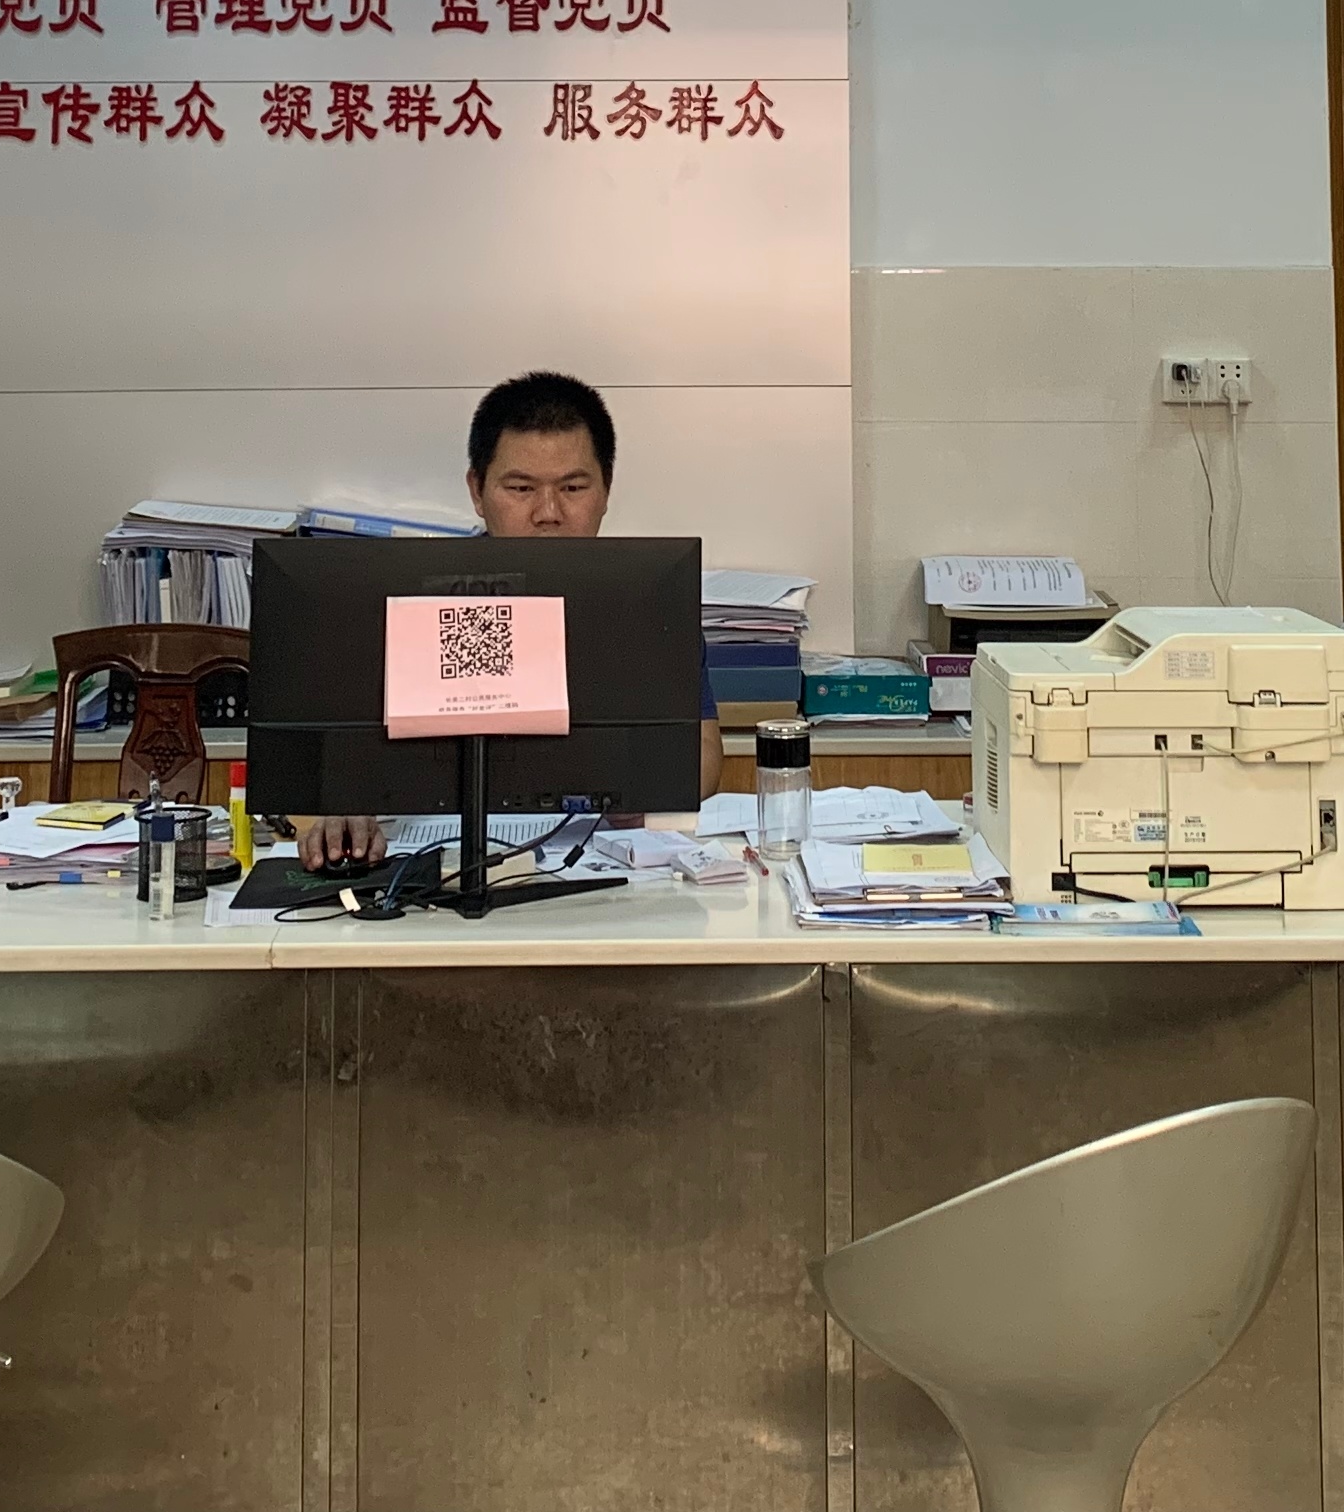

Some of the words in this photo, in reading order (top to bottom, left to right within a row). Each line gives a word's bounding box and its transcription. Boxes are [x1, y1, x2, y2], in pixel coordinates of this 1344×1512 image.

[260, 79, 504, 145] 凝聚群众
[542, 78, 786, 142] 服务群众
